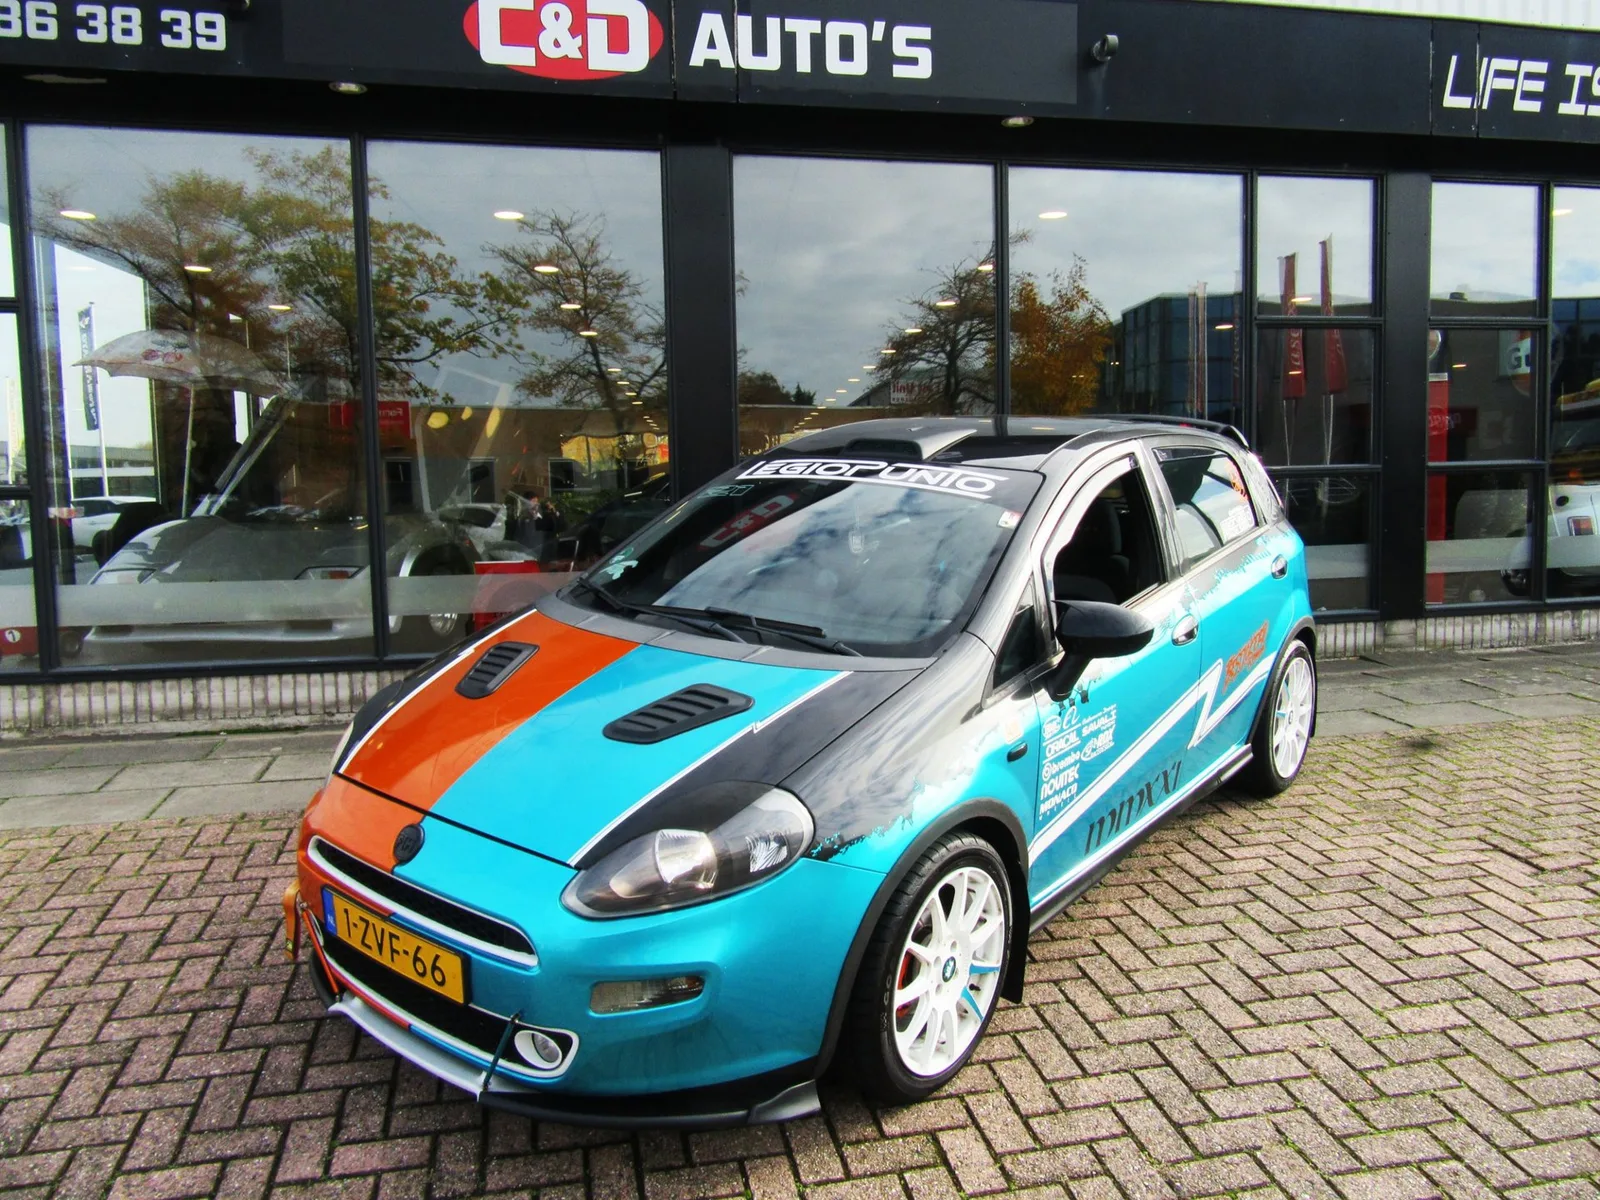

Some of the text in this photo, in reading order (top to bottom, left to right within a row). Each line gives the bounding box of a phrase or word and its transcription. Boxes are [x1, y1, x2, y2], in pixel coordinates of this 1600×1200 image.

[76, 4, 143, 45] 38
[160, 9, 227, 51] 39
[479, 0, 933, 79] C&D AUTO'S
[1442, 54, 1549, 113] LIFE
[343, 908, 447, 987] 1-ZVF-66
